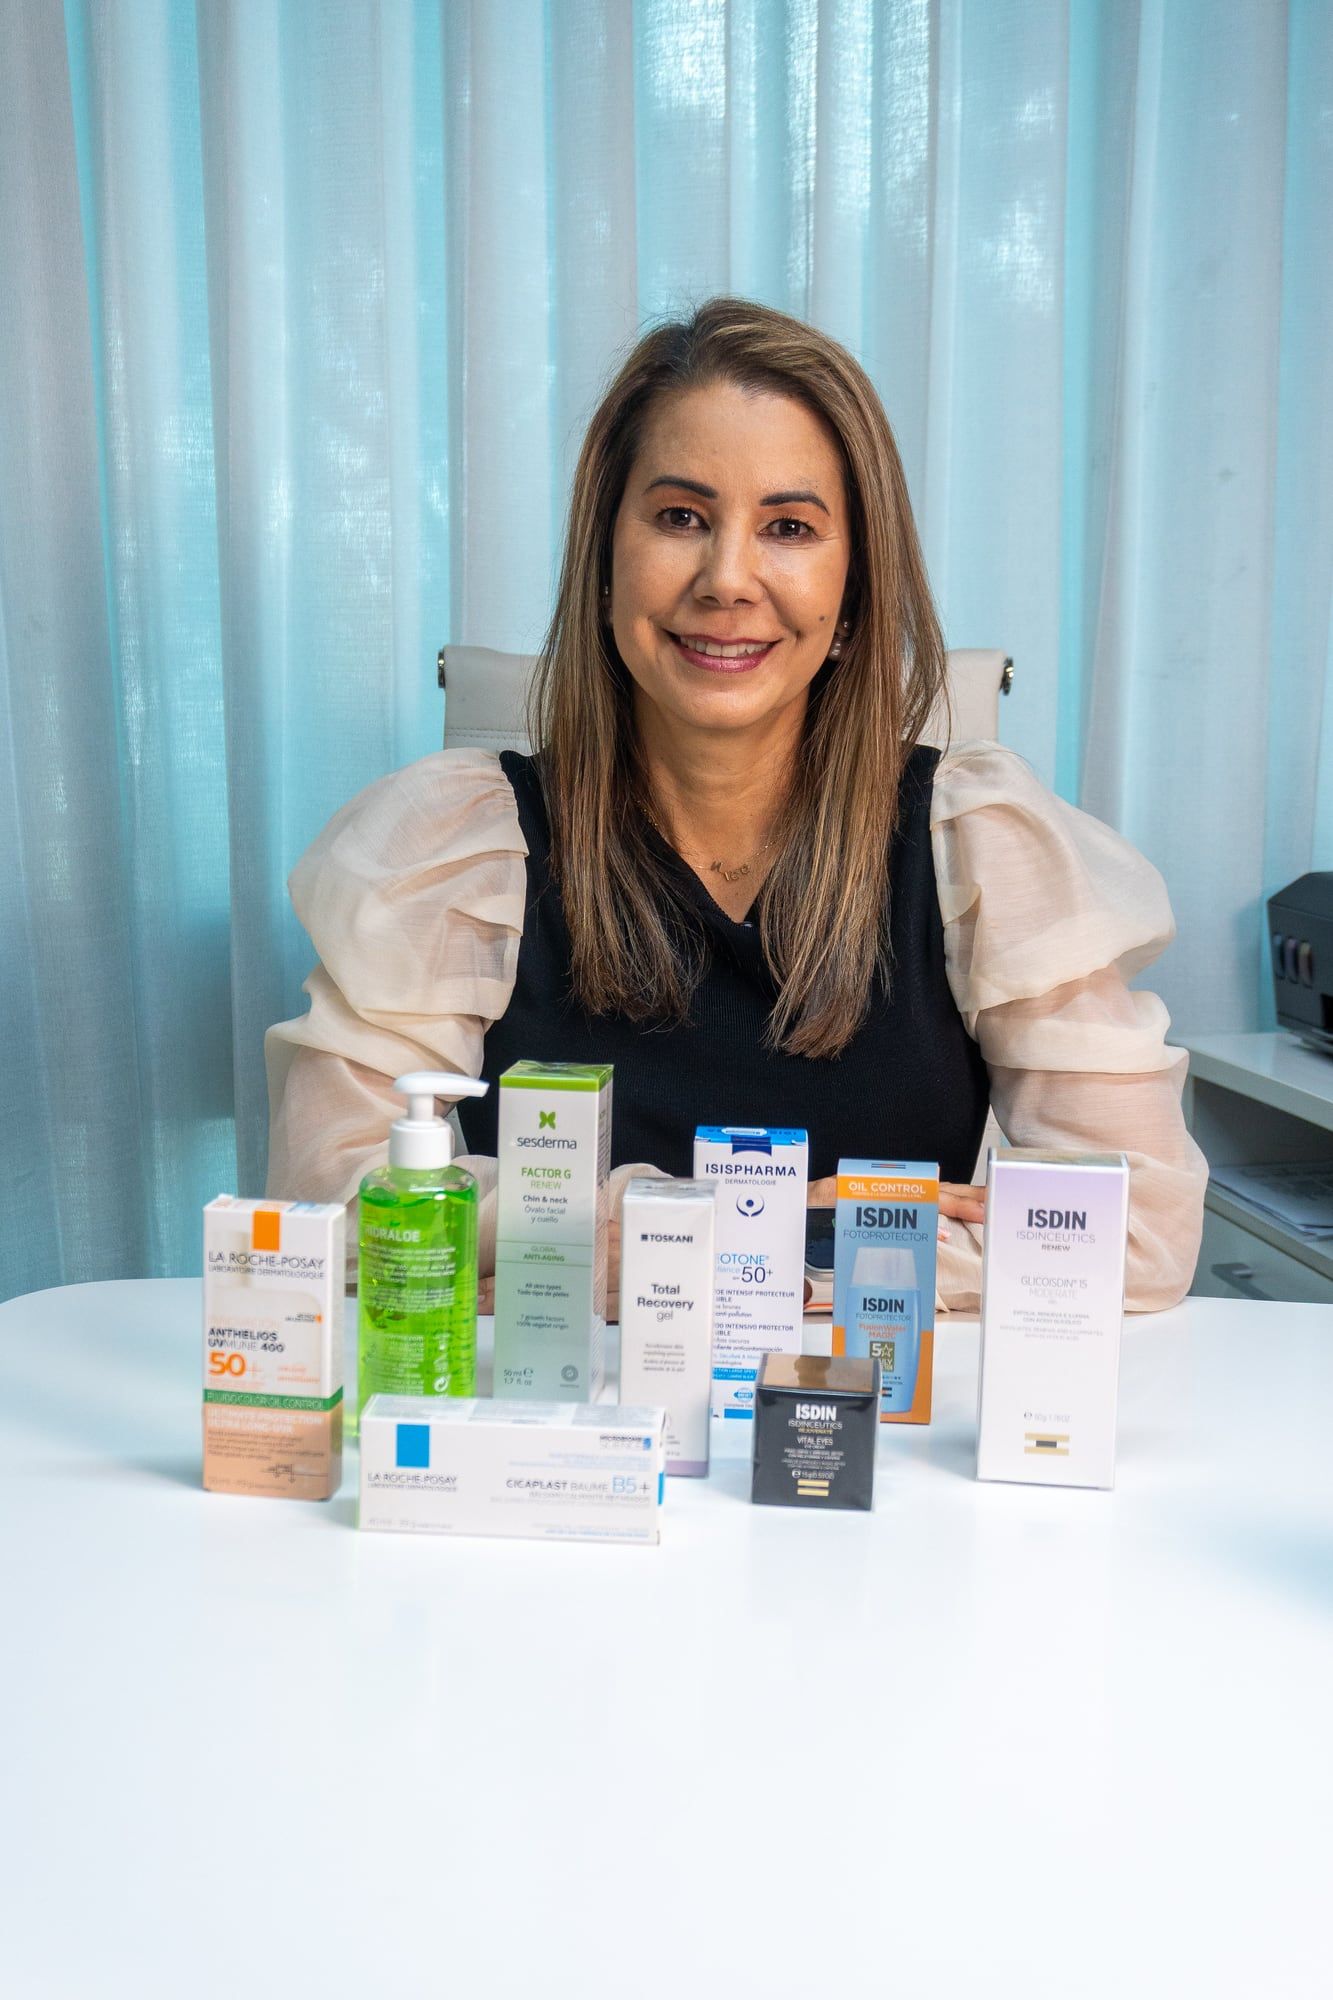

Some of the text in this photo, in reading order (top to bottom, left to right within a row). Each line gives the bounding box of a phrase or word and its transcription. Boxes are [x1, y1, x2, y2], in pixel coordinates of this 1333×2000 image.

[517, 1136, 576, 1149] sesderma
[521, 1167, 572, 1178] FACTOR G
[705, 1163, 796, 1176] ISISPHARMA
[530, 1180, 561, 1189] RENEW
[724, 1178, 776, 1186] DERMATOLOGIE
[848, 1181, 926, 1194] OIL CONTROL
[522, 1194, 569, 1204] Chin & neck
[546, 1205, 567, 1214] facial
[536, 1215, 559, 1223] cuello
[855, 1205, 917, 1229] ISDIN
[1027, 1208, 1086, 1230] ISDIN
[650, 1234, 693, 1243] TOSKANI
[843, 1229, 928, 1241] FOTOPROTECTOR
[1016, 1230, 1096, 1243] ISDINCEUTICS
[1041, 1244, 1070, 1252] RENEW
[208, 1251, 325, 1269] LA ROCHE-POSAY
[523, 1253, 564, 1261] ANTI-AGING
[651, 1283, 680, 1295] Total
[726, 1289, 753, 1297] INTENSIF
[755, 1290, 794, 1298] PROTECTEUR
[637, 1297, 693, 1310] Recovery
[862, 1297, 904, 1313] ISDIN
[656, 1310, 674, 1322] gel
[855, 1312, 911, 1321] FOTOPROTECTOR
[725, 1323, 756, 1331] INTENSIVO
[758, 1324, 793, 1332] PROTECTOR
[208, 1328, 278, 1342] ANTHELIOS
[208, 1339, 286, 1352] UVMUNE 400
[795, 1403, 836, 1420] ISDIN
[788, 1419, 842, 1429] ISDINCEUTICS
[796, 1435, 834, 1446] VITAL EYES
[367, 1472, 457, 1485] LA ROCHE-POSAY
[506, 1478, 567, 1491] CICAPLAST
[570, 1481, 607, 1492] BAUME
